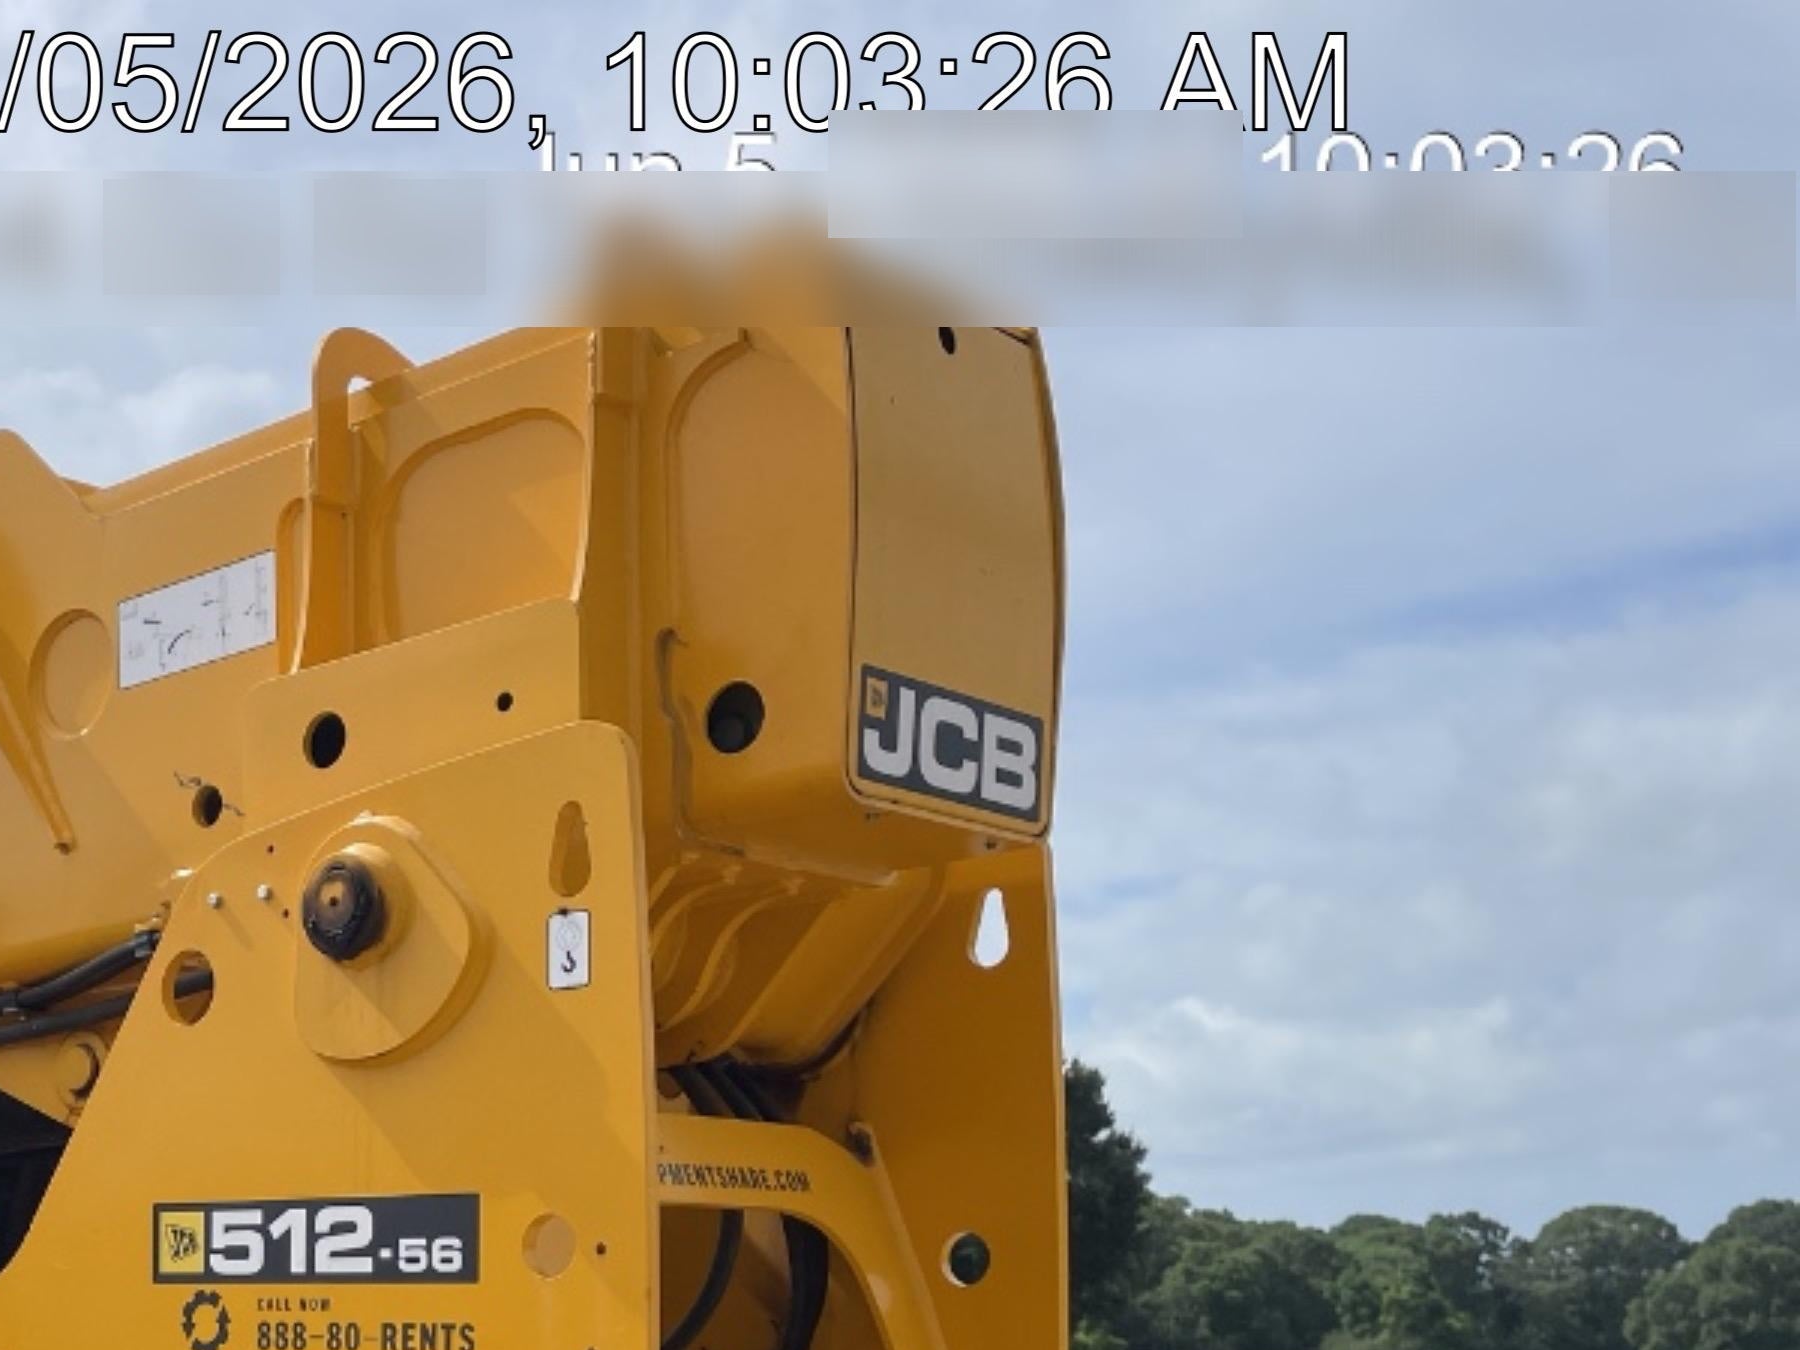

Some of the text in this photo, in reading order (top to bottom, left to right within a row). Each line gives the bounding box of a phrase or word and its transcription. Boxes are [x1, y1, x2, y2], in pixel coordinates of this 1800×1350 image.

[863, 686, 1036, 810] JCB
[257, 1297, 331, 1312] CALL NOW
